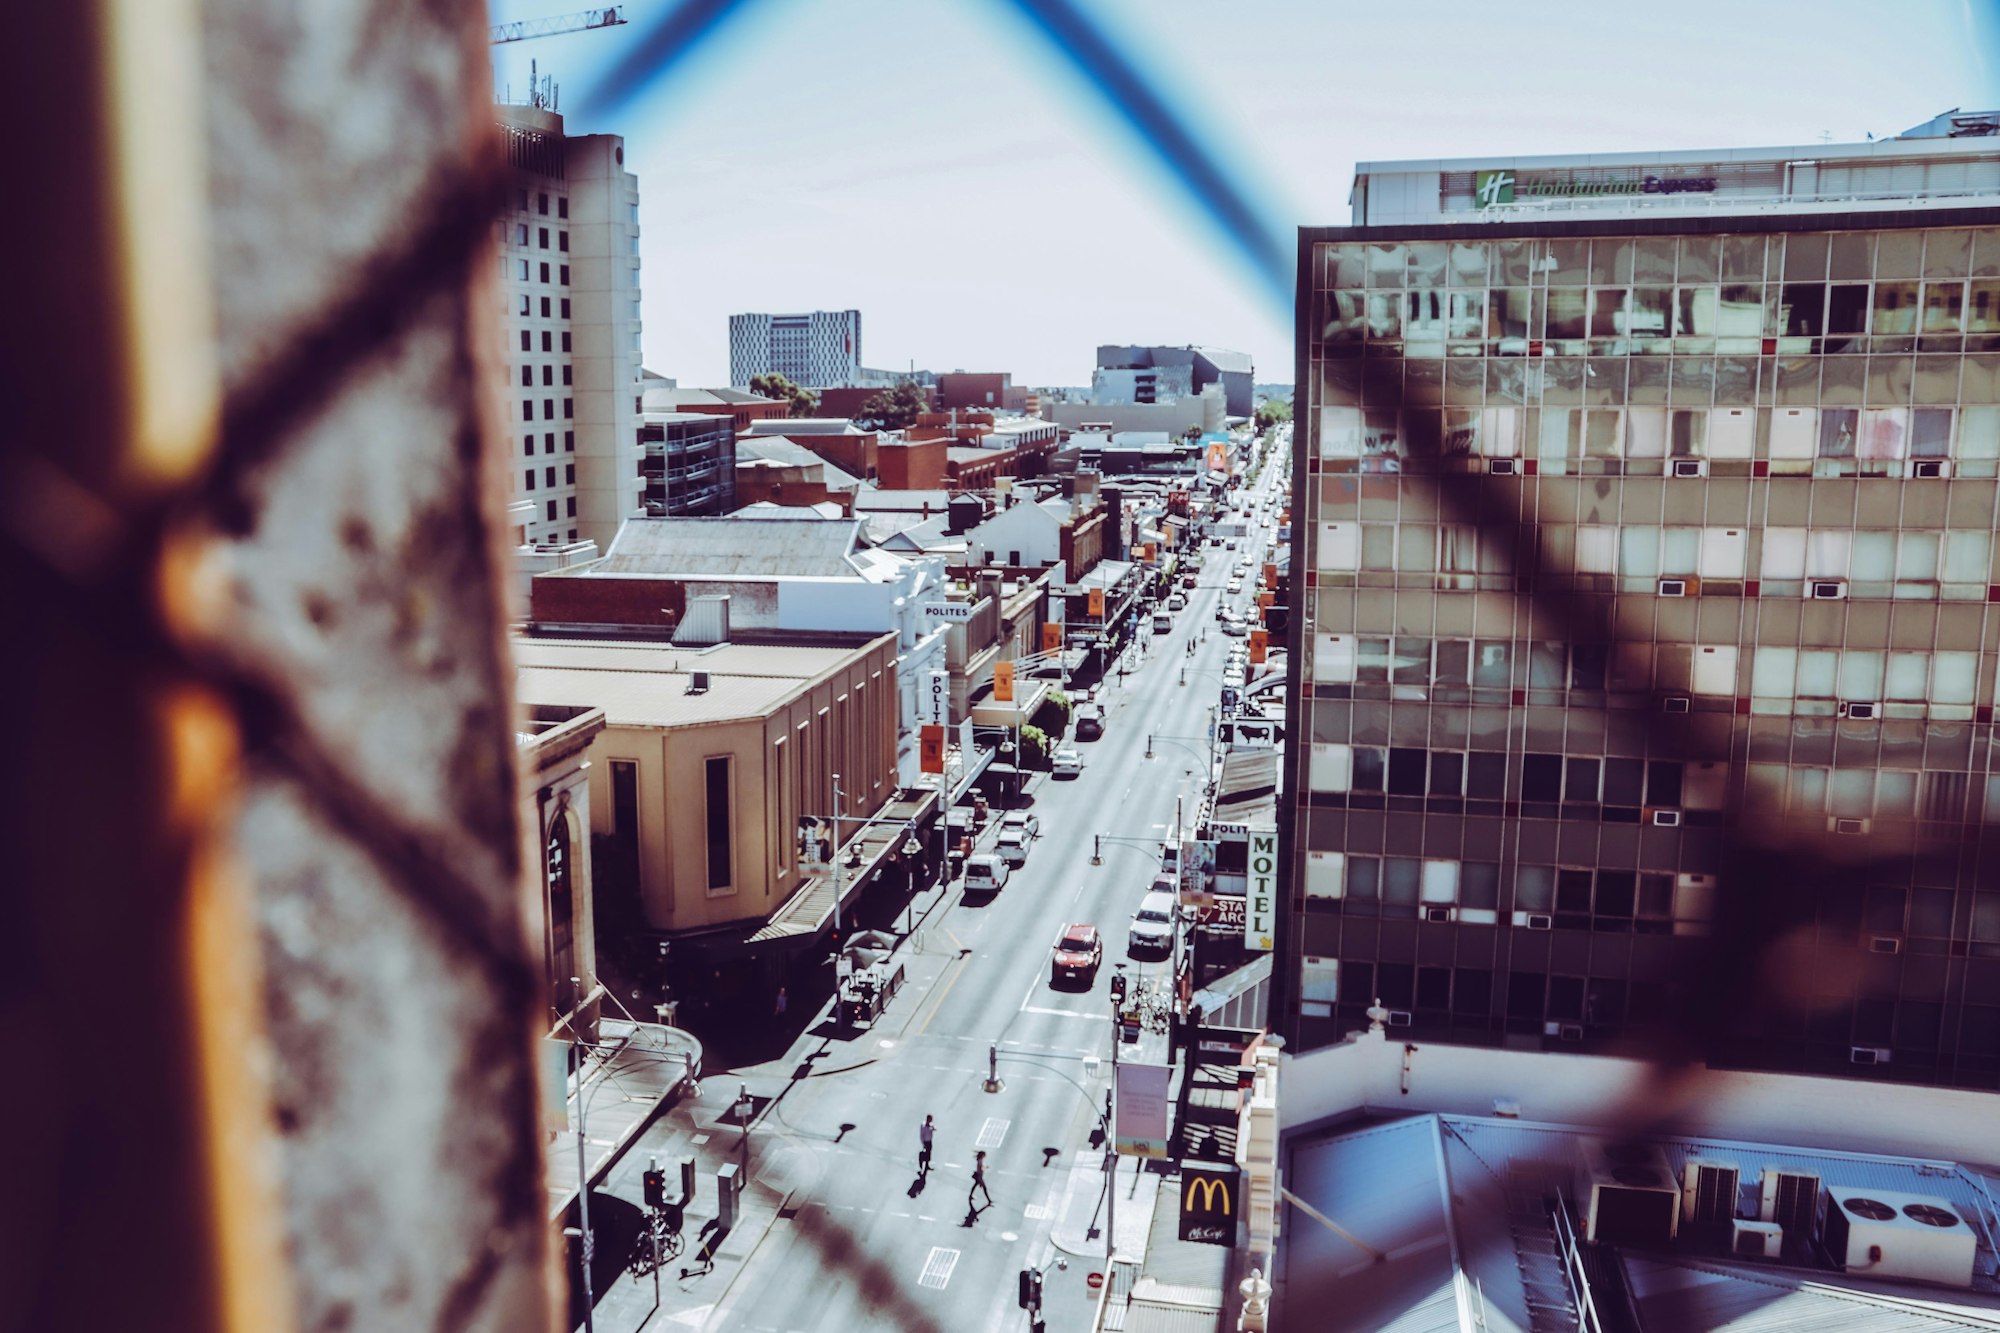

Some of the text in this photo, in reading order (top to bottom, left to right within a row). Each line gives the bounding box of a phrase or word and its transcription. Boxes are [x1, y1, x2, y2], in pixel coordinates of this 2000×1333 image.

[1527, 175, 1605, 197] Holiday
[925, 606, 968, 617] POLITES
[1253, 836, 1274, 934] MOTEL
